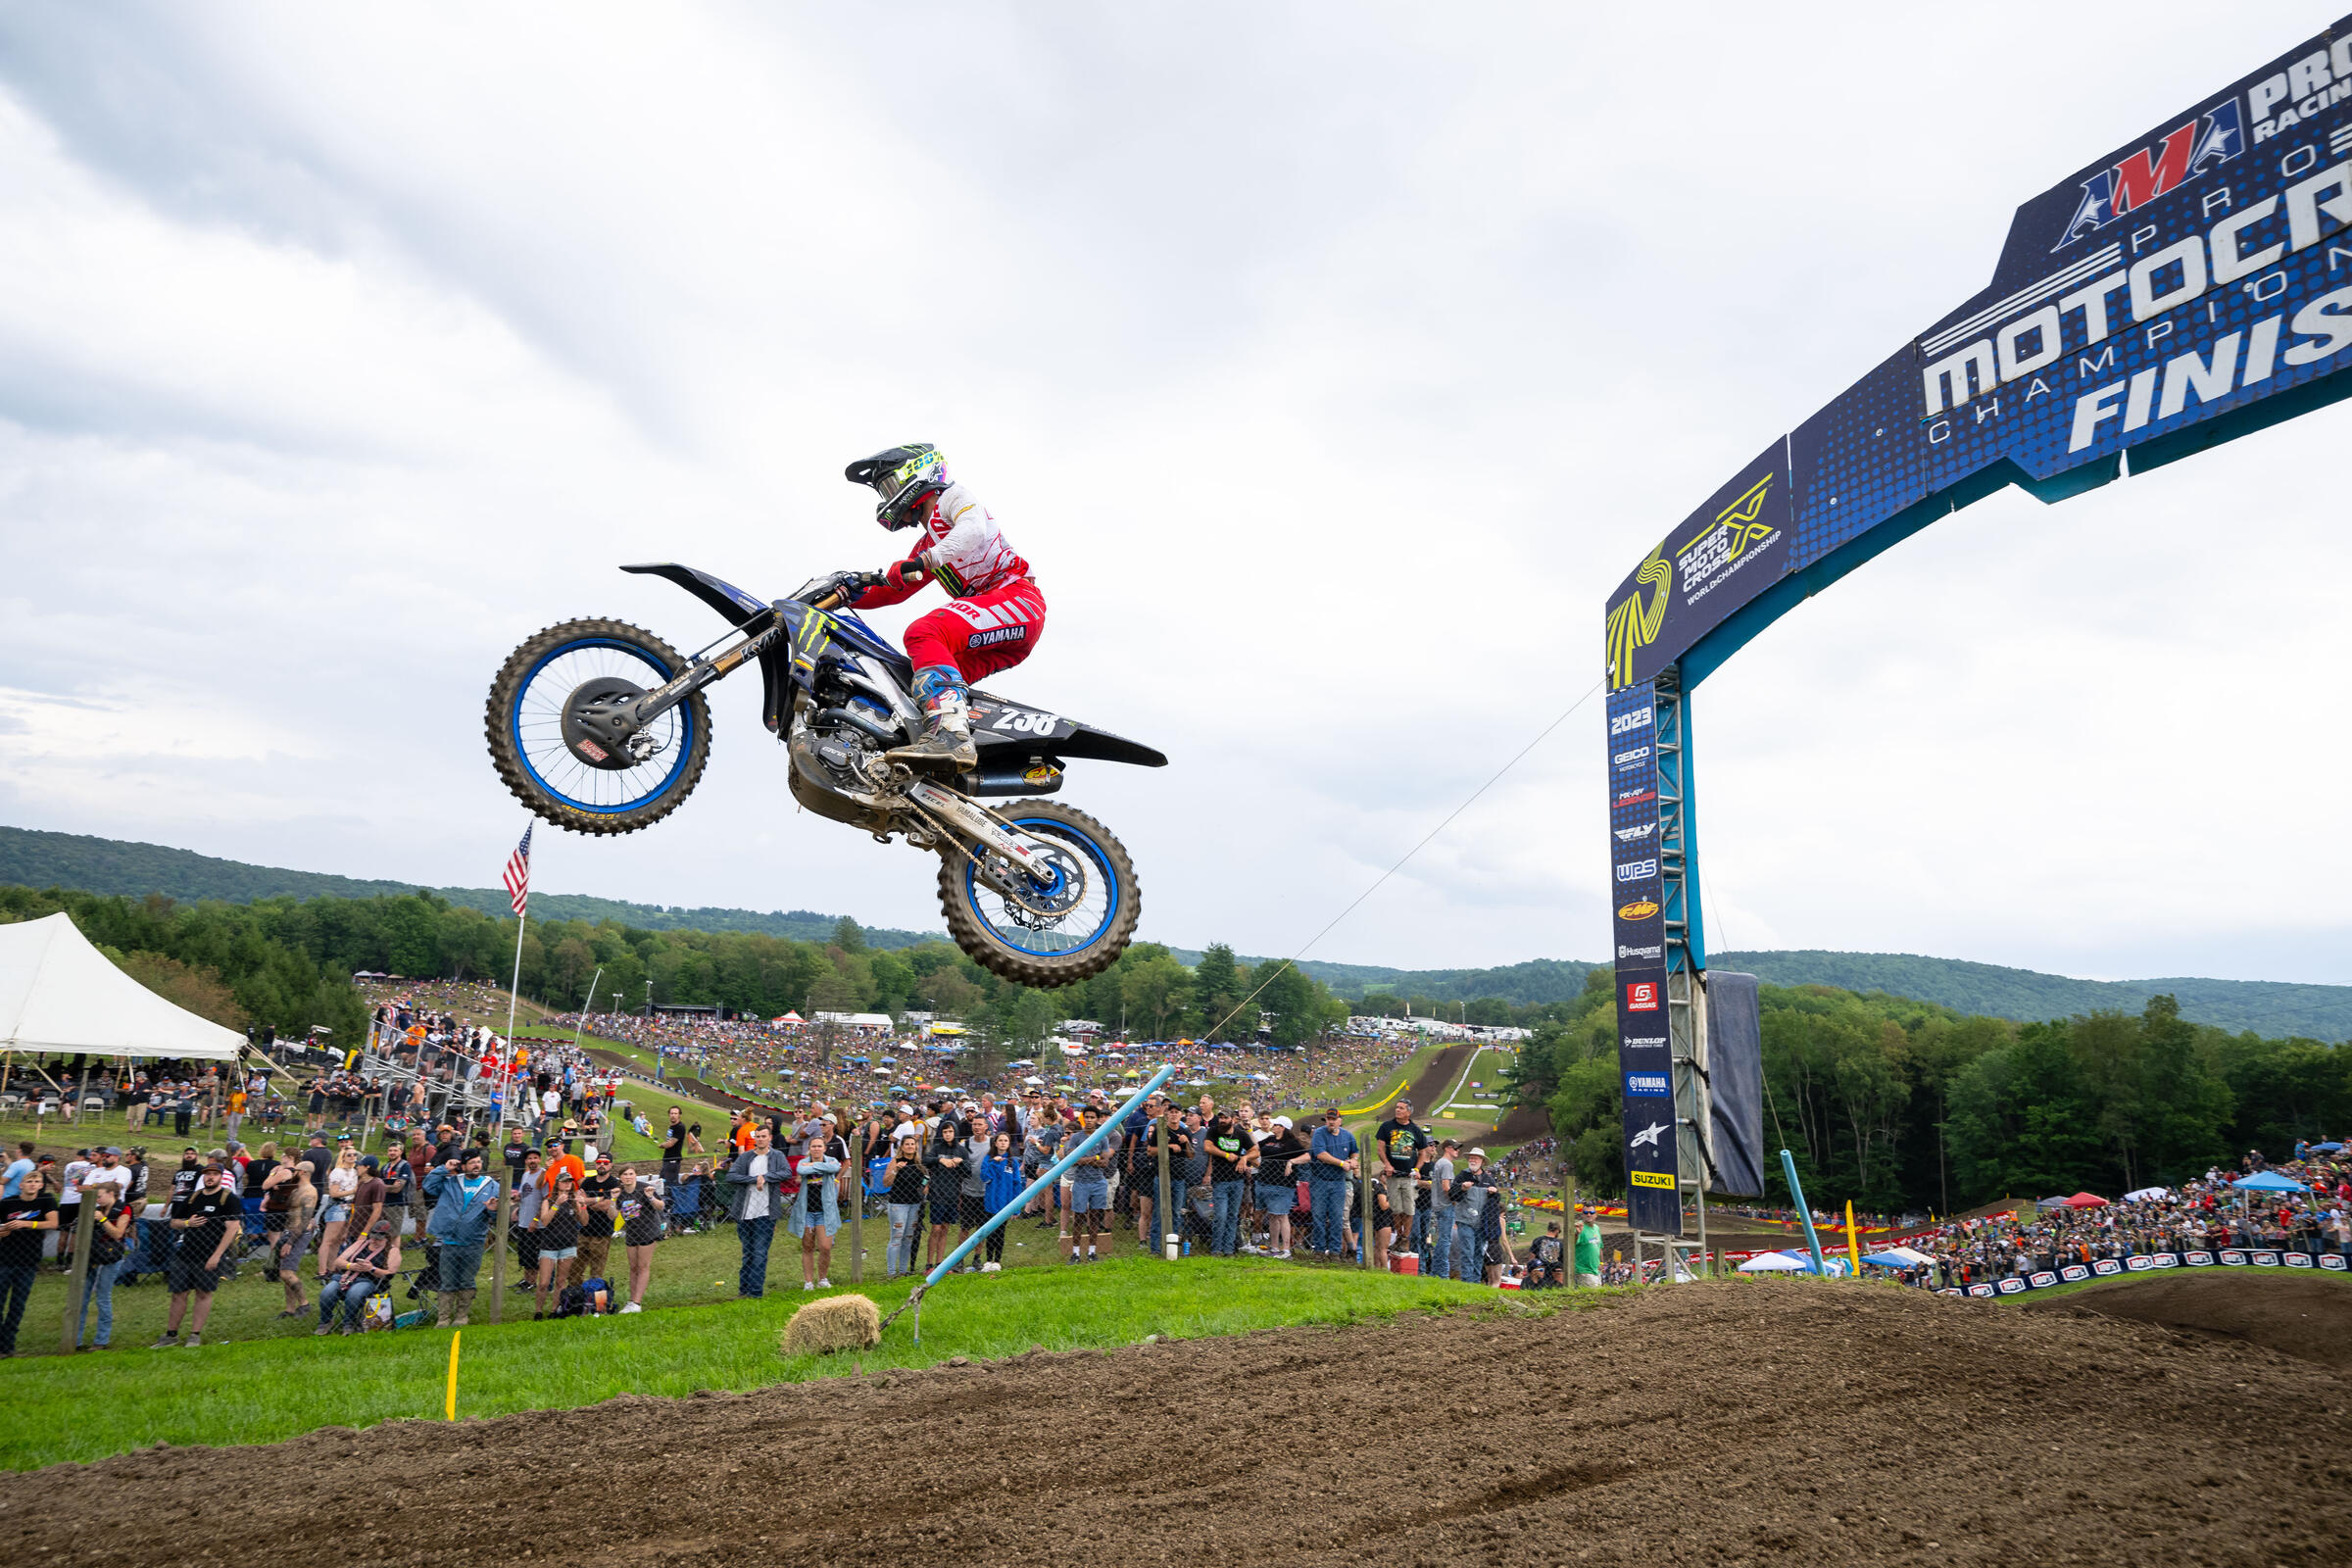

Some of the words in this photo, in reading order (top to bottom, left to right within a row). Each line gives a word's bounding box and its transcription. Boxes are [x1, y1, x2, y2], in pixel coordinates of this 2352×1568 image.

[2049, 96, 2245, 254] AMA
[1679, 524, 1728, 571] SUPER
[1684, 537, 1729, 580] MOTO
[1683, 547, 1732, 593] CROSS
[1687, 579, 1717, 606] WORLD
[1716, 530, 1782, 584] CHAMPIONSHIP
[943, 601, 981, 620] HOR
[982, 626, 1025, 645] YAMAHA
[992, 708, 1061, 736] 238
[1611, 706, 1652, 735] 2023
[1614, 746, 1649, 764] GEICO
[956, 804, 988, 828] YAMALUBE
[1617, 858, 1657, 881] WPS
[1638, 1077, 1666, 1088] YAMAHA
[1634, 1174, 1671, 1186] SUZUKI
